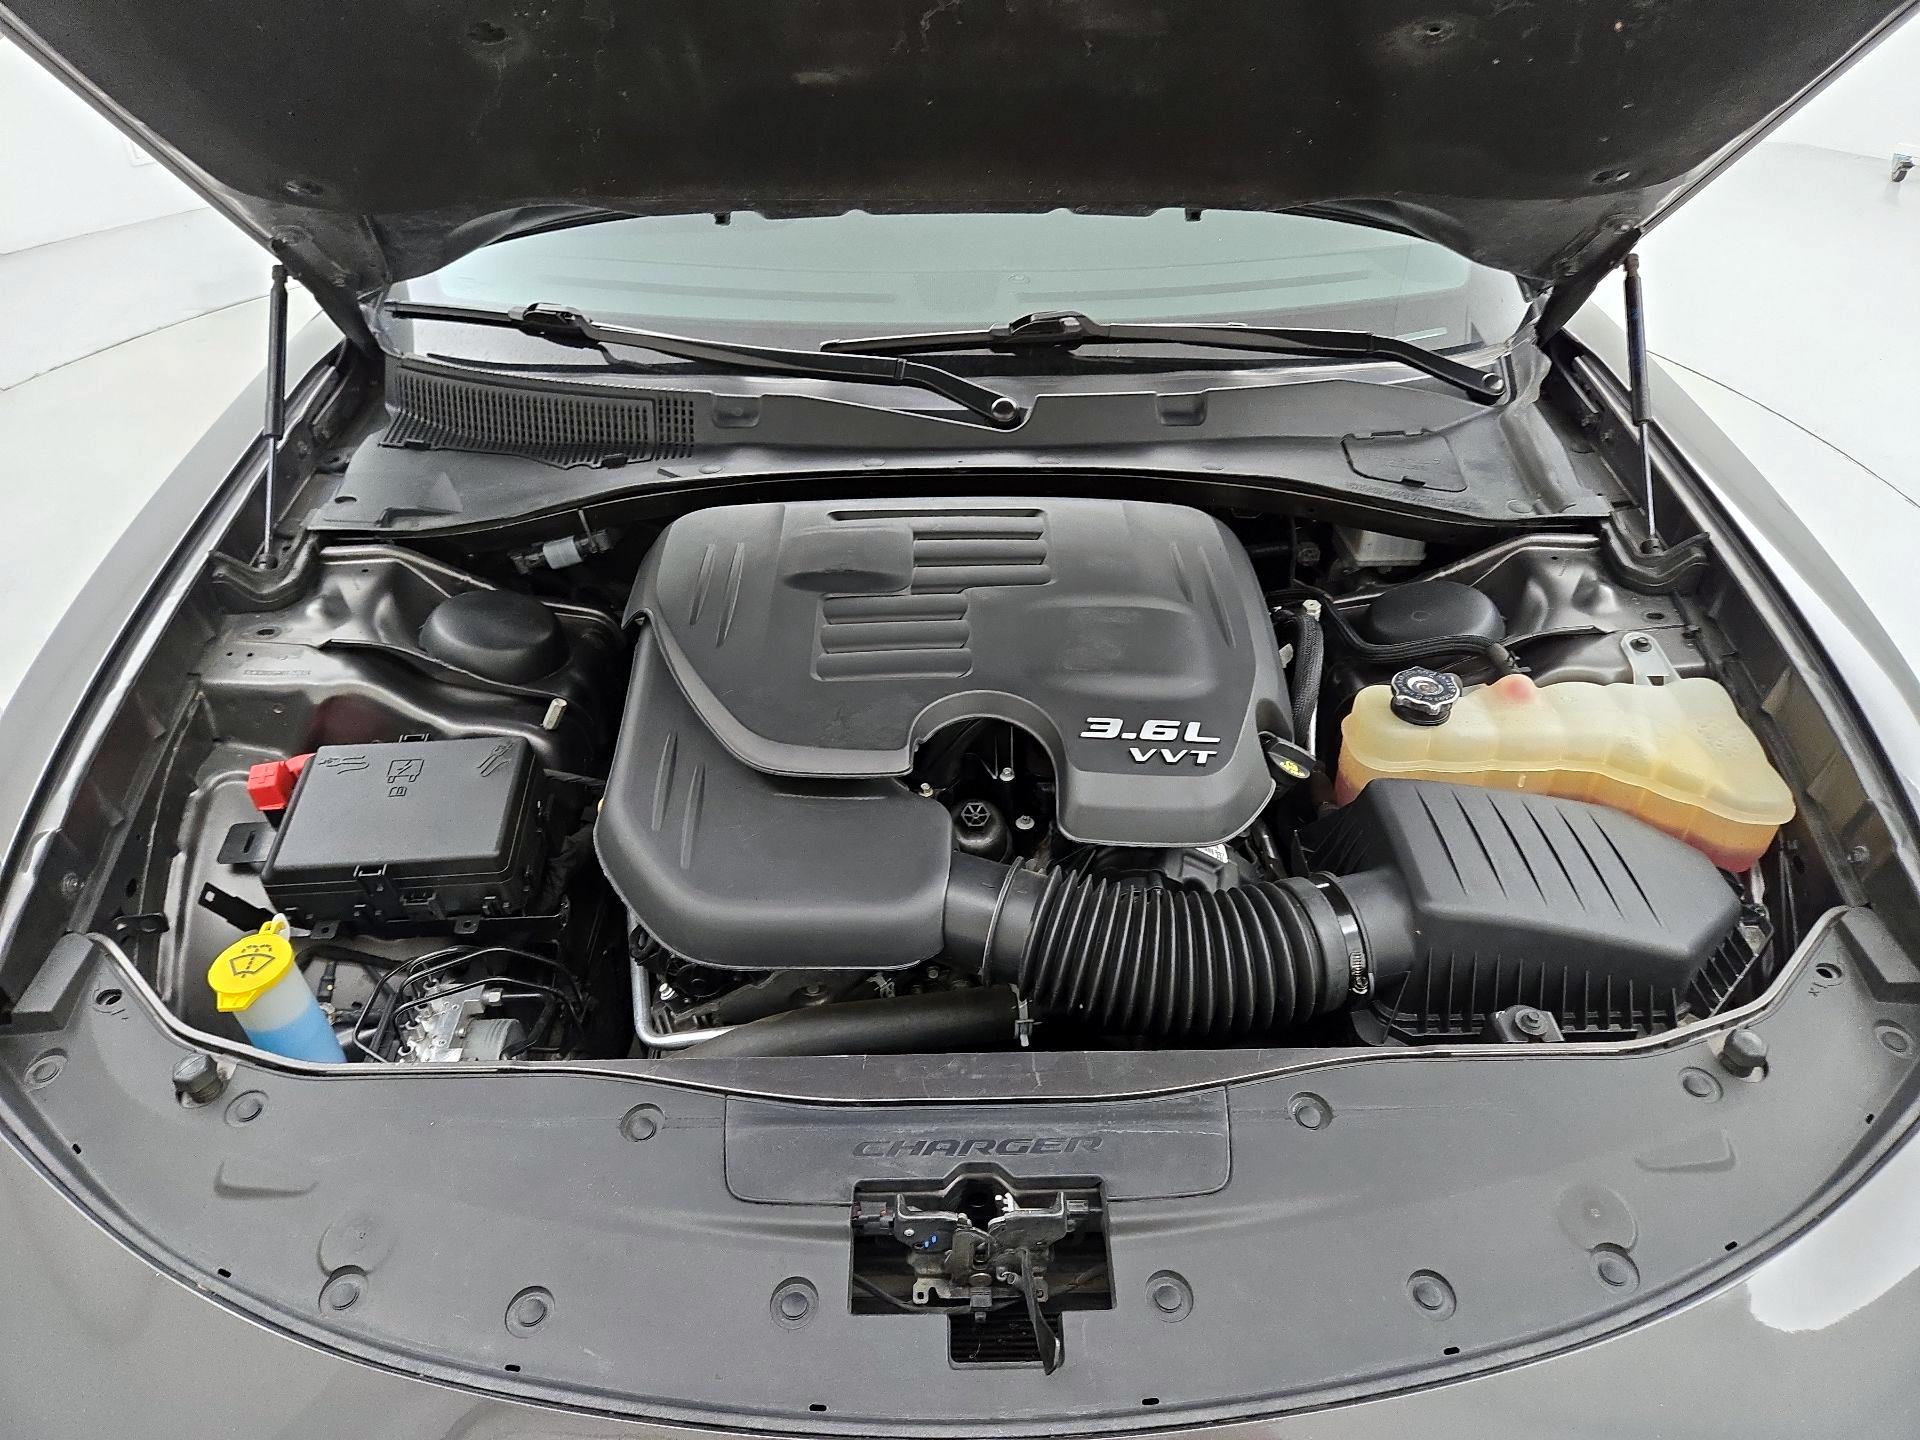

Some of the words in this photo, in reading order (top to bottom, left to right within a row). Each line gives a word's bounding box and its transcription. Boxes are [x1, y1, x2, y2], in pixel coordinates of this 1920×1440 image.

[1080, 717, 1221, 743] 3.6L
[1128, 747, 1218, 765] VVT
[852, 1136, 1104, 1157] CHARGER
